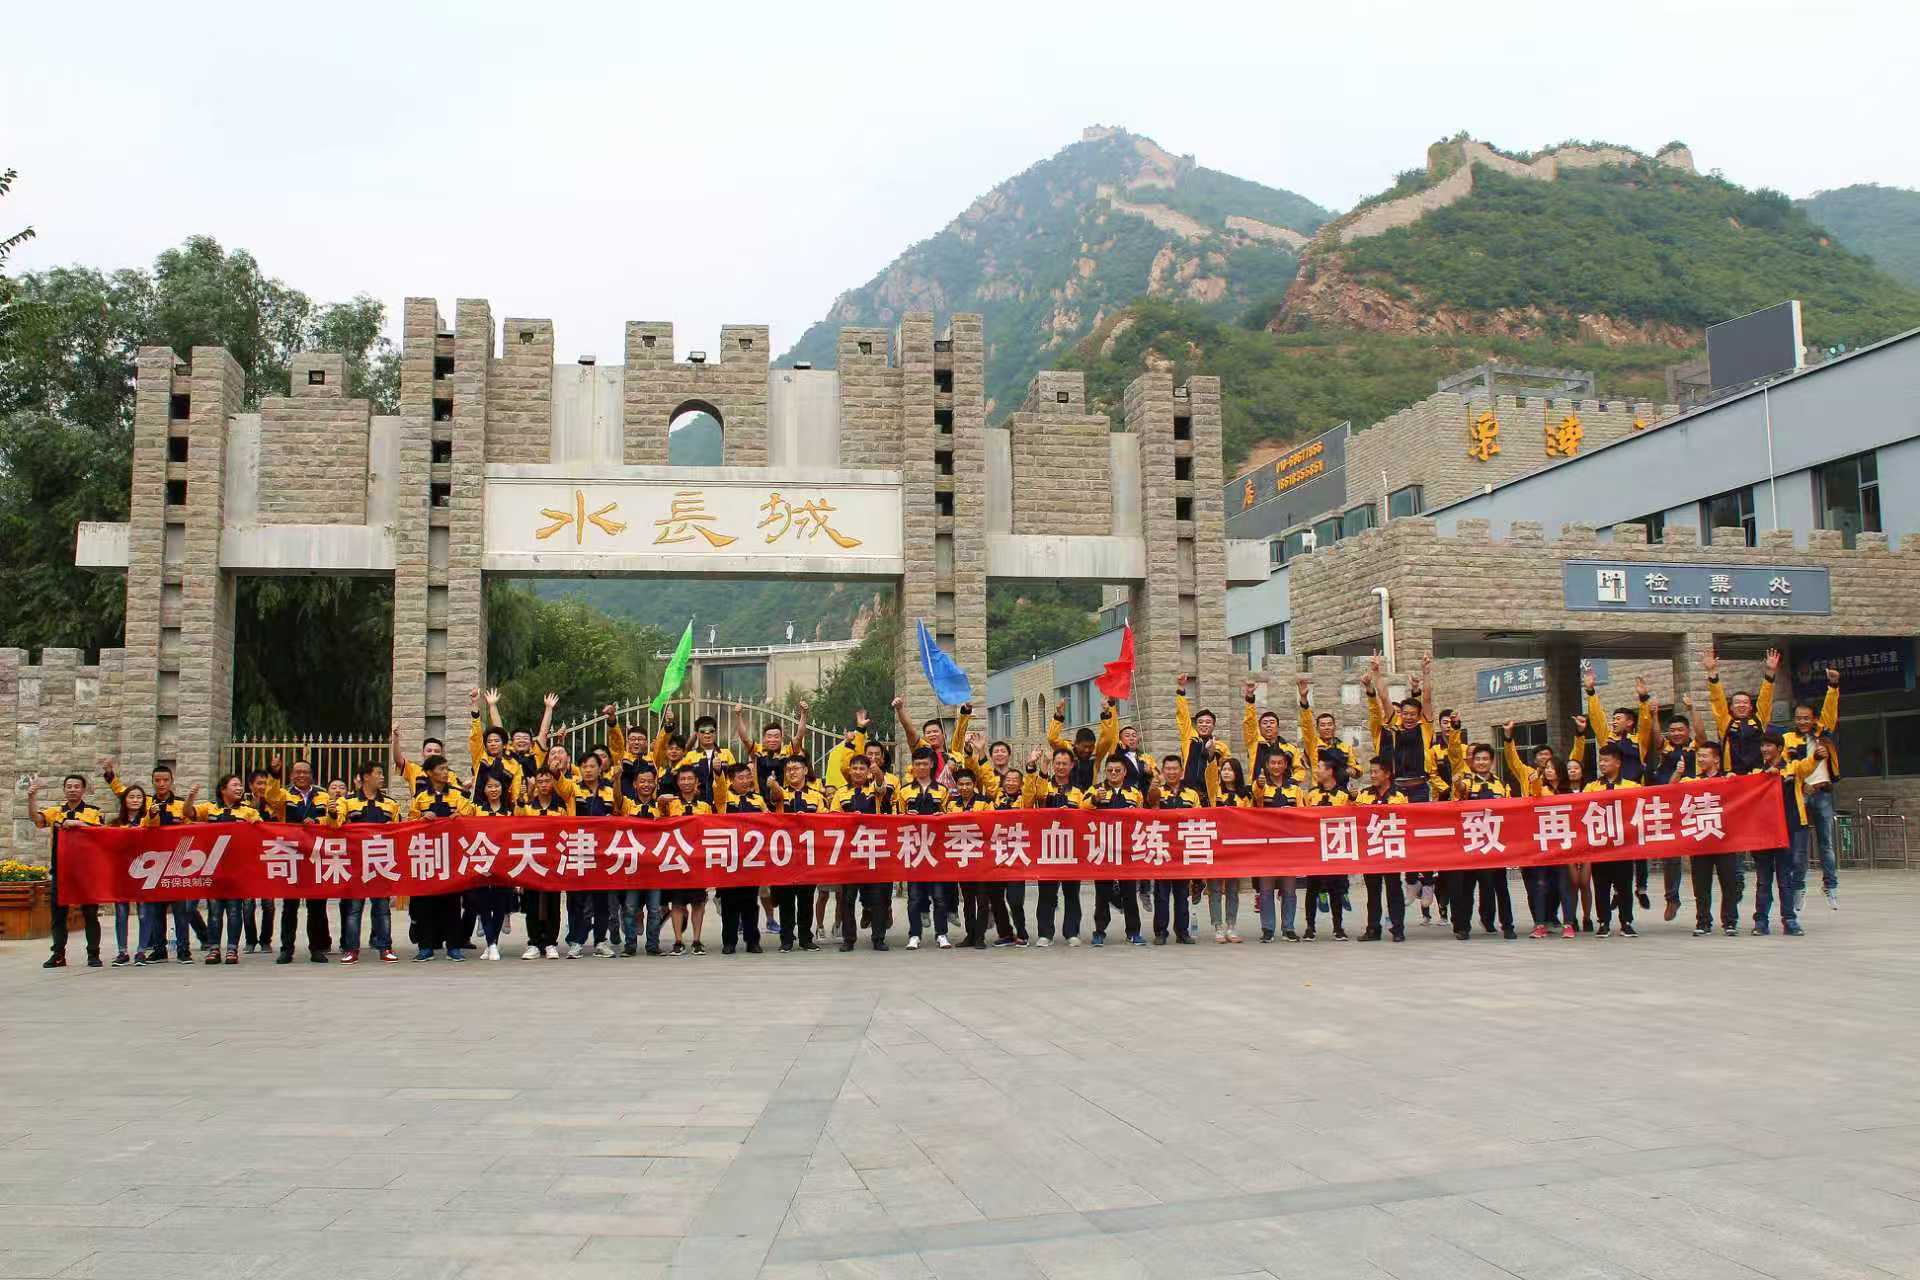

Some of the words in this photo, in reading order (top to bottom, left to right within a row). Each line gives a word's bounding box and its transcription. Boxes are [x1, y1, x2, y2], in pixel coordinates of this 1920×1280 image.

[1644, 572, 1793, 594] 检票处
[1649, 595, 1701, 606] TICKET
[1711, 596, 1789, 608] ENTRANCE
[1532, 791, 1726, 853] 再创佳绩
[160, 877, 213, 888] 奇保良制冷
